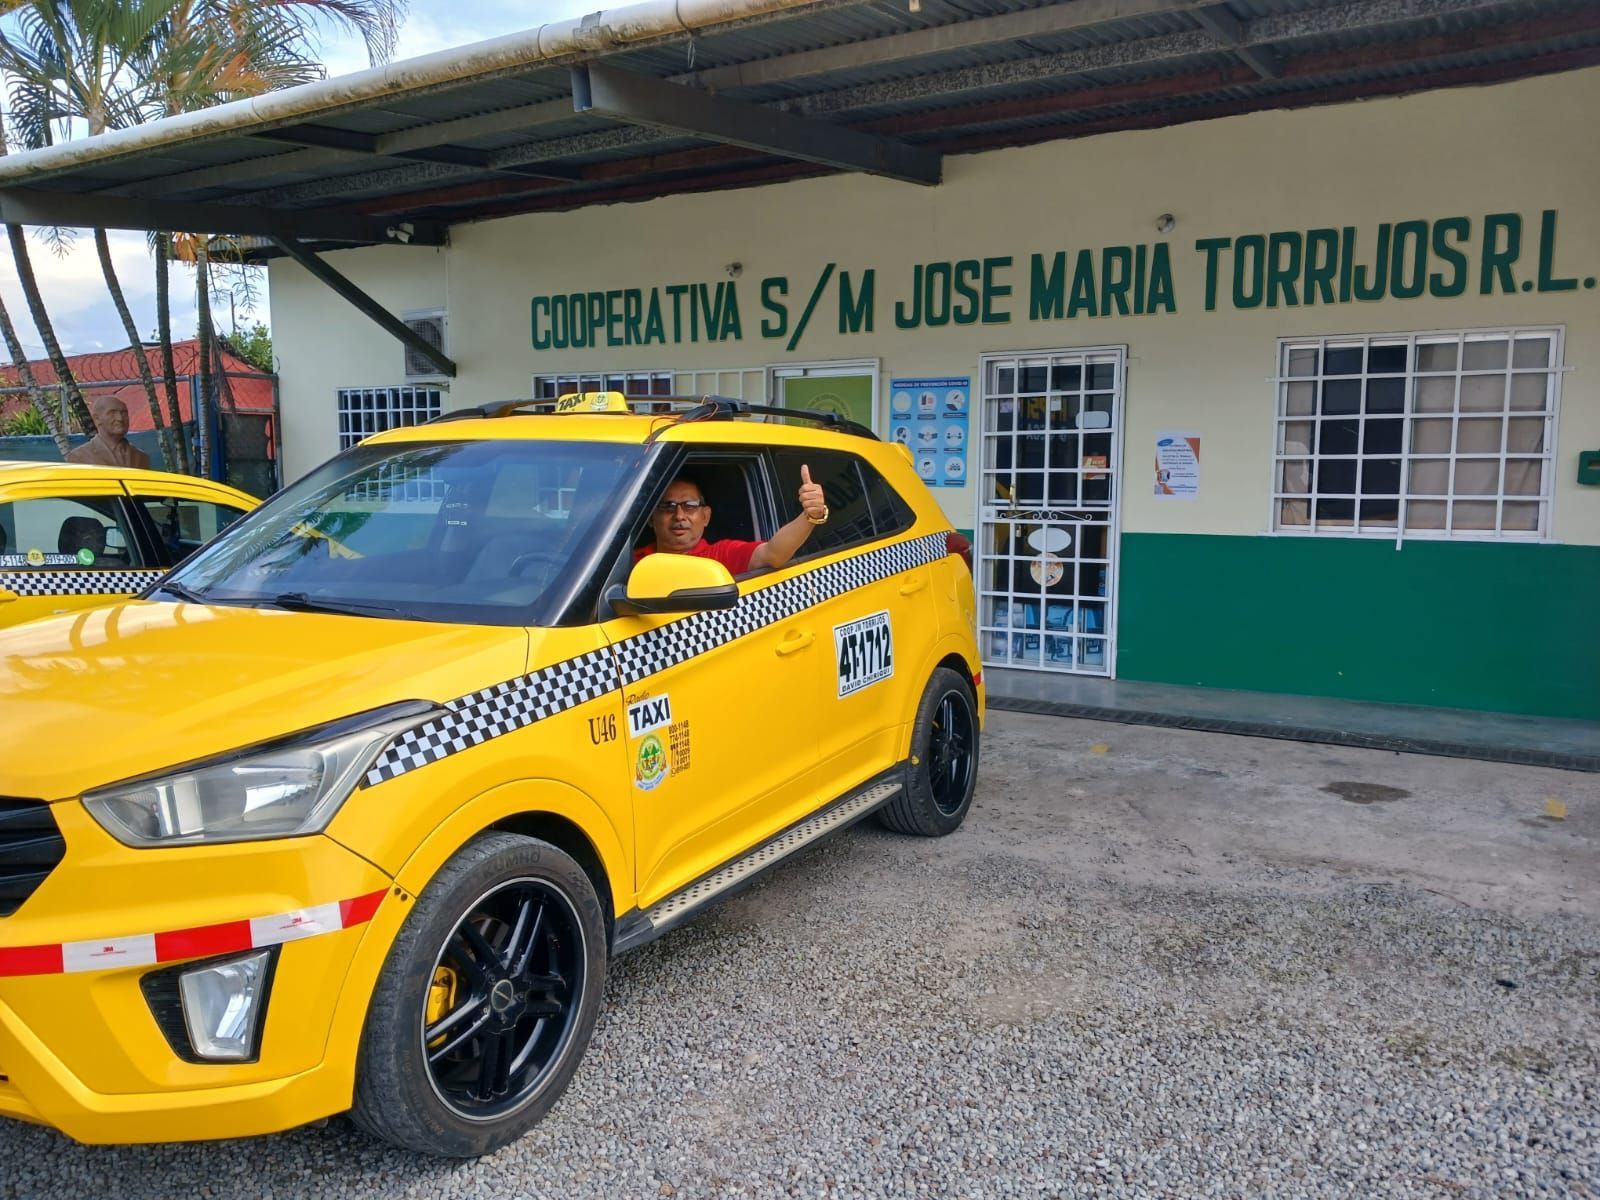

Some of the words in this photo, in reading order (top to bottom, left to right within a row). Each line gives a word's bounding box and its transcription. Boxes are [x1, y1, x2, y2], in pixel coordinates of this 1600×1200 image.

[531, 280, 742, 350] COOPERATIVA
[760, 263, 875, 351] S/M
[895, 256, 1013, 329] JOSE
[1029, 242, 1177, 320] MARIA
[1195, 216, 1470, 312] TORRIJOS
[1479, 209, 1597, 295] R.L.
[559, 392, 586, 411] TAXI
[842, 680, 861, 692] DAVID
[588, 713, 617, 745] U46
[629, 697, 671, 731] TAXI
